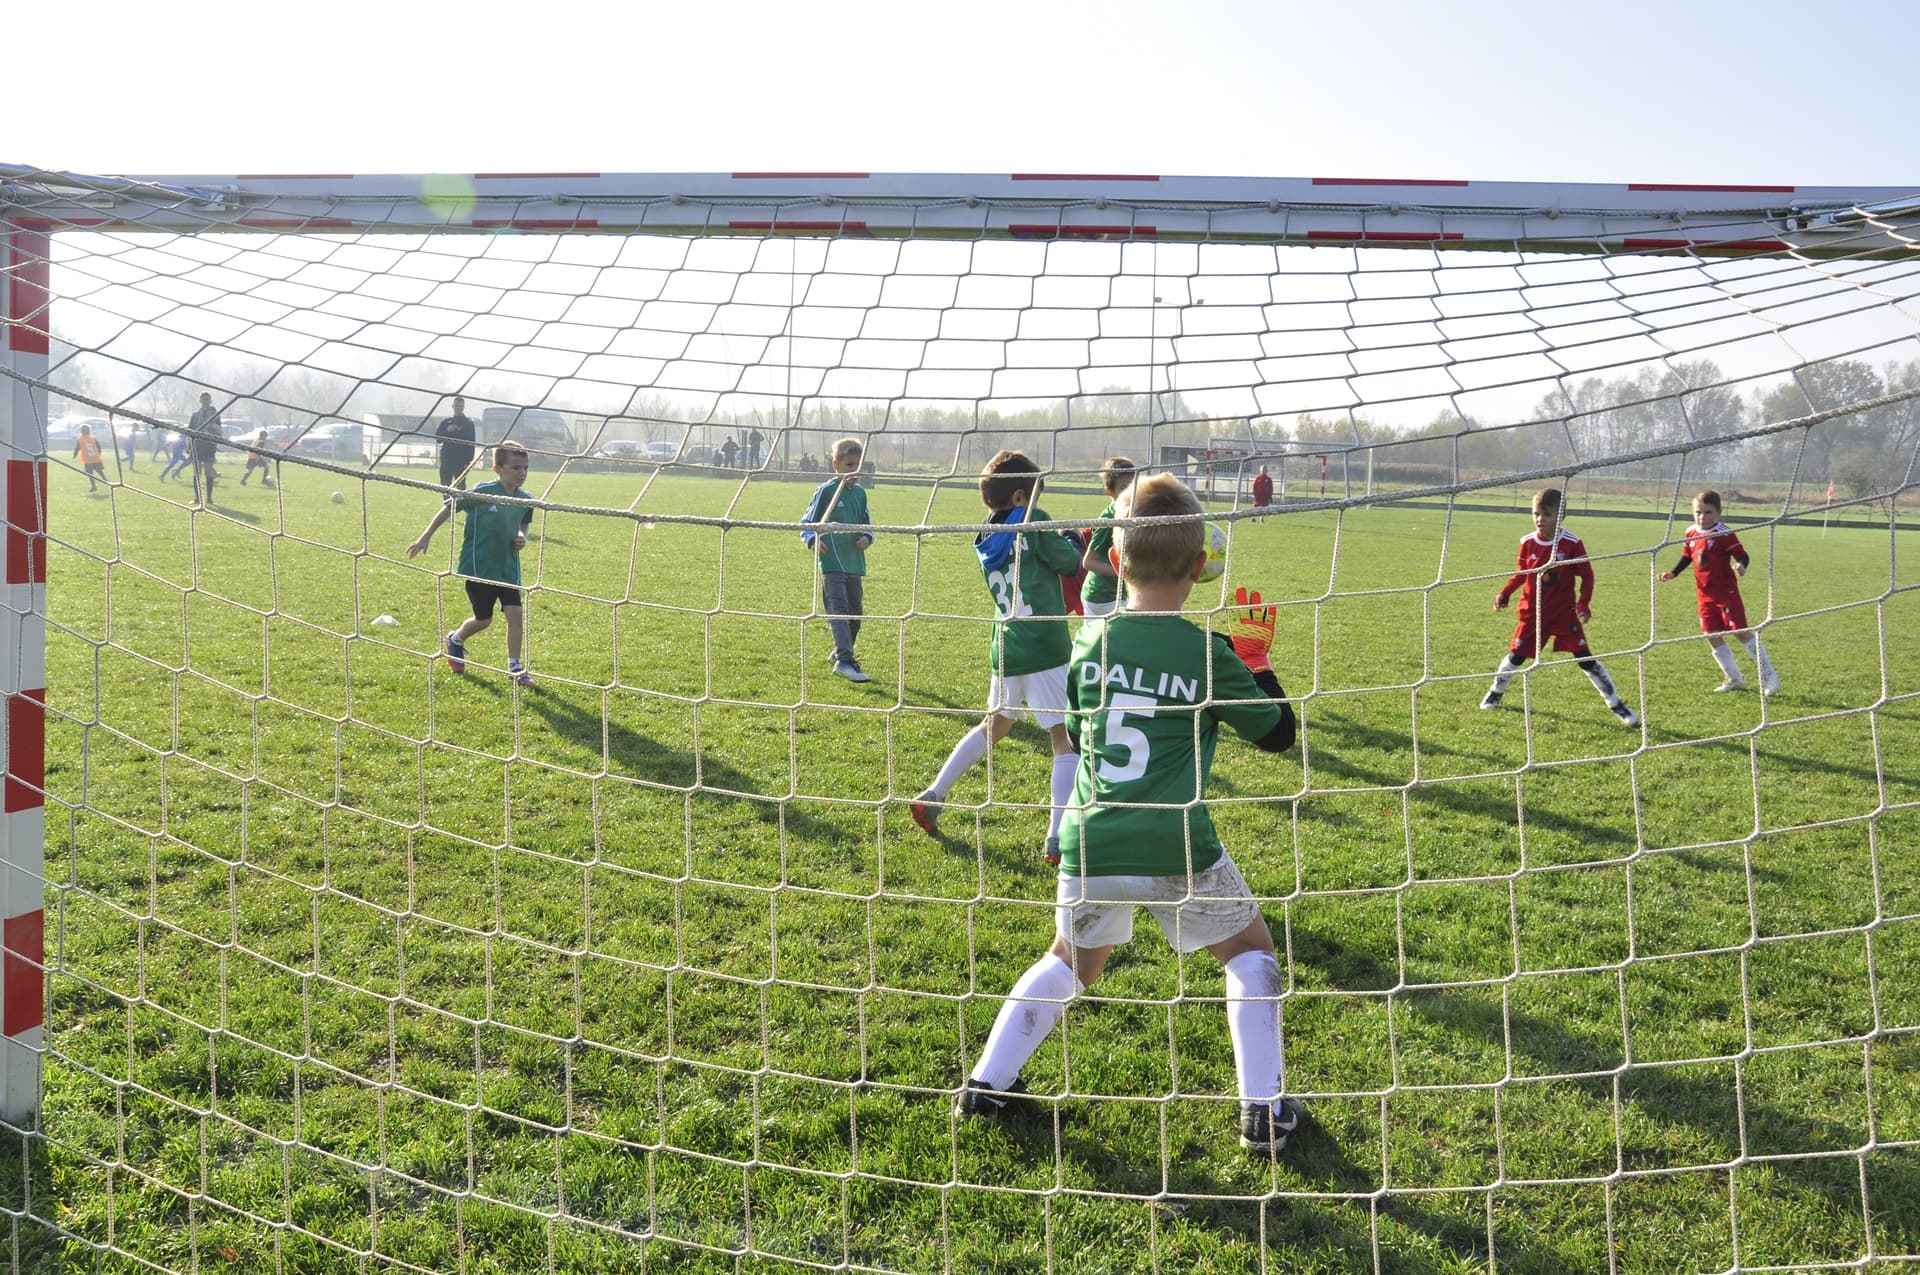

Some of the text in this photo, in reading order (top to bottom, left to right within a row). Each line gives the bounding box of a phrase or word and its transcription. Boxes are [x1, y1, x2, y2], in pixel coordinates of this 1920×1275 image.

[988, 562, 1033, 619] 31
[1081, 661, 1198, 702] DALIN
[1097, 692, 1158, 783] 5
